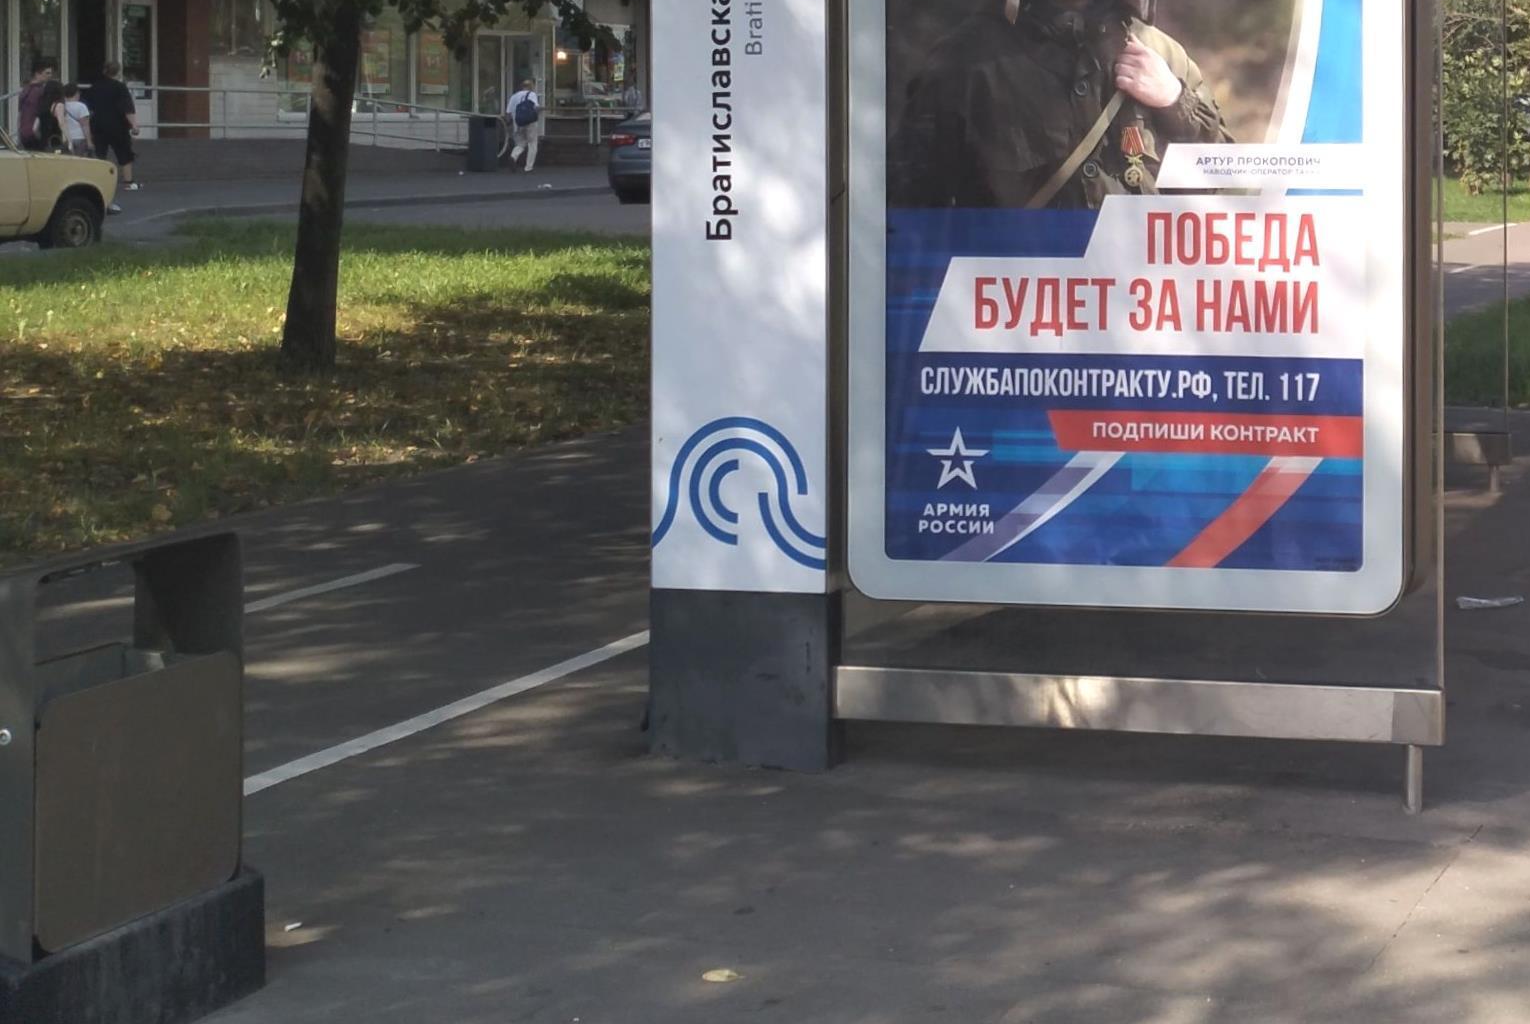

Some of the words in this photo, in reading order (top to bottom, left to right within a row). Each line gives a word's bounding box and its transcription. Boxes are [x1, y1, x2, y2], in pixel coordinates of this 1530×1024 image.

[1196, 156, 1234, 166] АРТУР
[1237, 156, 1321, 167] ПРОКОПОВИЧ
[1146, 211, 1321, 272] ПОБЕДА
[974, 277, 1116, 336] БУДЕТ
[1128, 278, 1182, 332] ЗА
[1196, 279, 1320, 334] НАМИ
[920, 366, 1218, 403] СЛУЖБАПОКОНТРАКТУ.РФ,
[1225, 371, 1270, 401] ТЕЛ.
[1279, 373, 1320, 402] 117
[1092, 421, 1205, 442] ПОДПИШИ
[1211, 424, 1320, 443] КОНТРАКТ
[922, 503, 991, 519] АРМИЯ
[918, 519, 995, 535] РОССИИ
